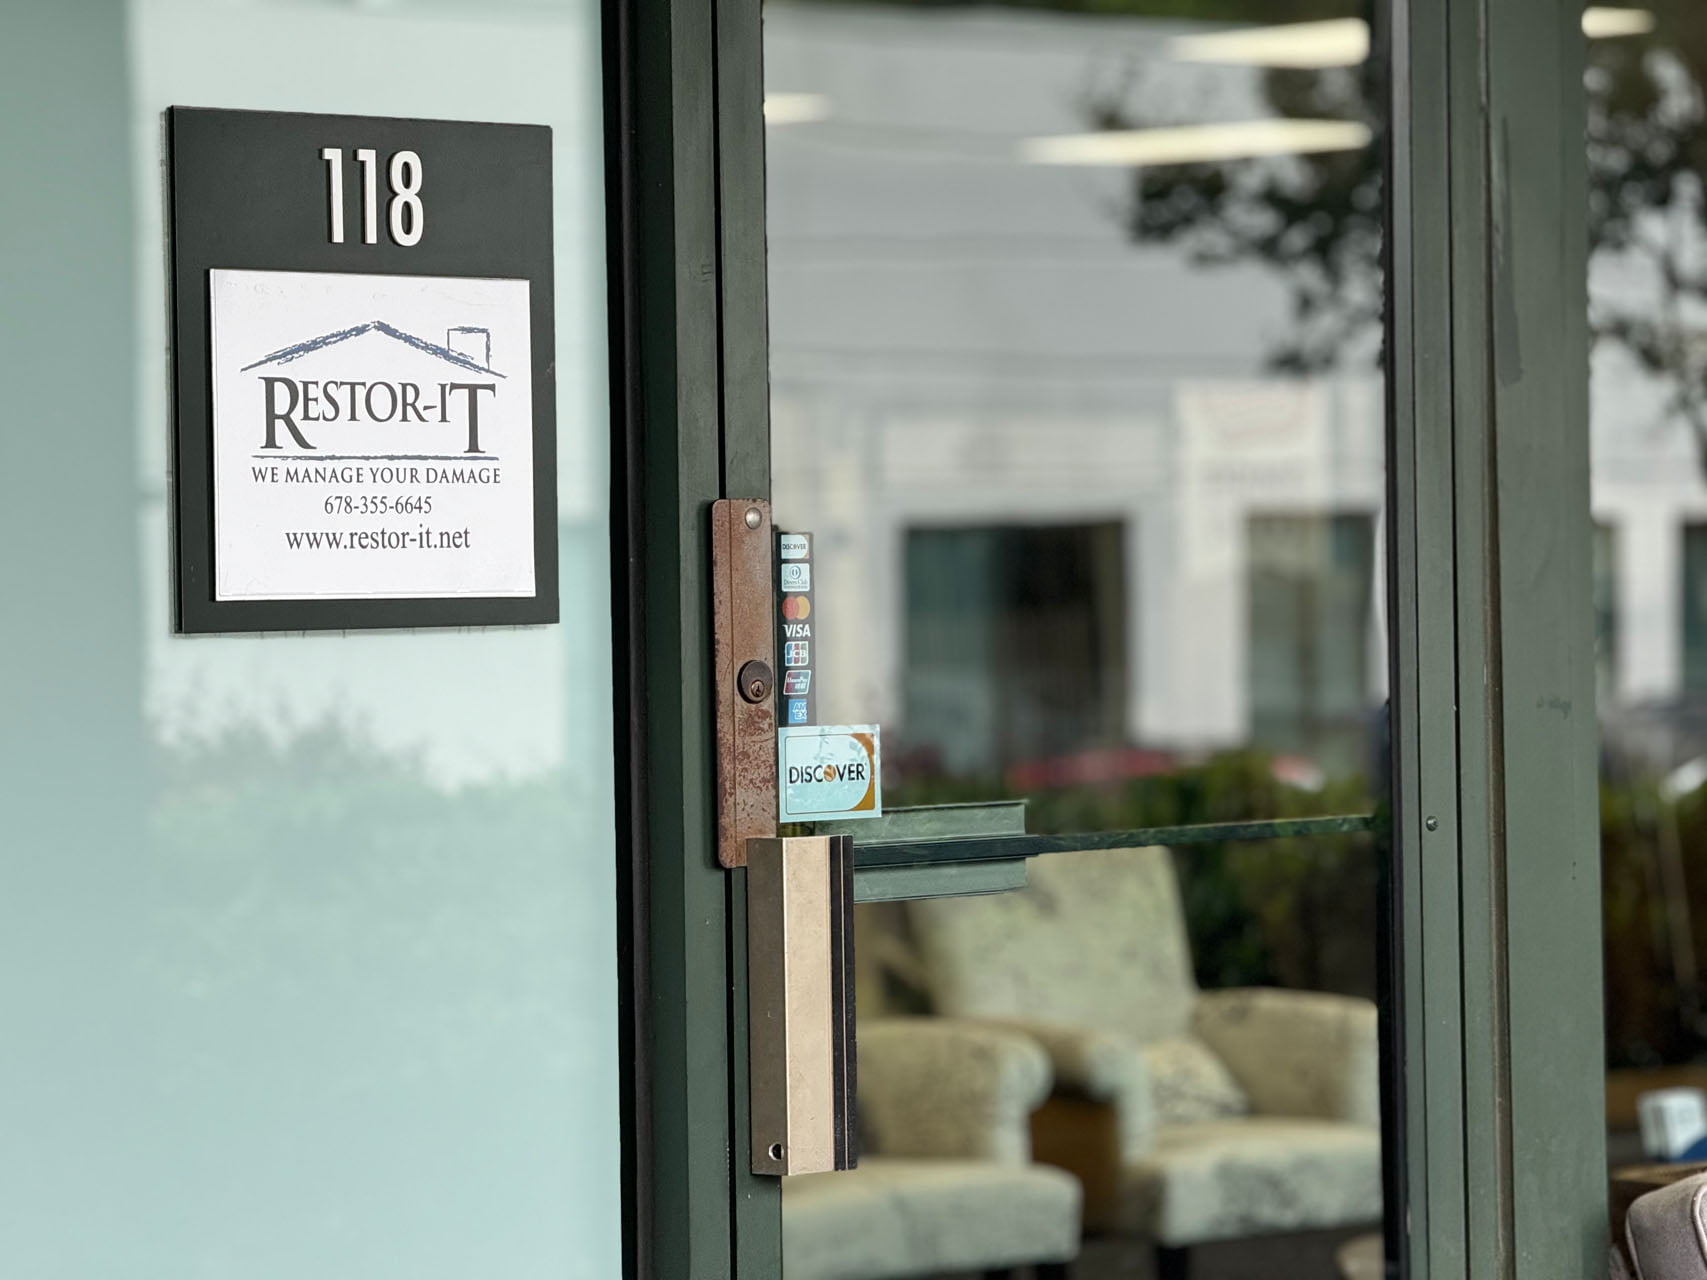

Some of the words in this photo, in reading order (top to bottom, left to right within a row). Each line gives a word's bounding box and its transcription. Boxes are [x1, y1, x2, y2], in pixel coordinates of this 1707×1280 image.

[321, 148, 424, 247] 118
[251, 467, 280, 484] WE
[285, 467, 364, 484] MANAGE
[370, 467, 424, 484] YOUR
[426, 467, 501, 484] DAMAGE
[324, 495, 433, 515] 678-355-6645
[285, 524, 471, 550] www.restor-it.net
[783, 624, 811, 637] VISA
[789, 763, 865, 784] DISCOVER
